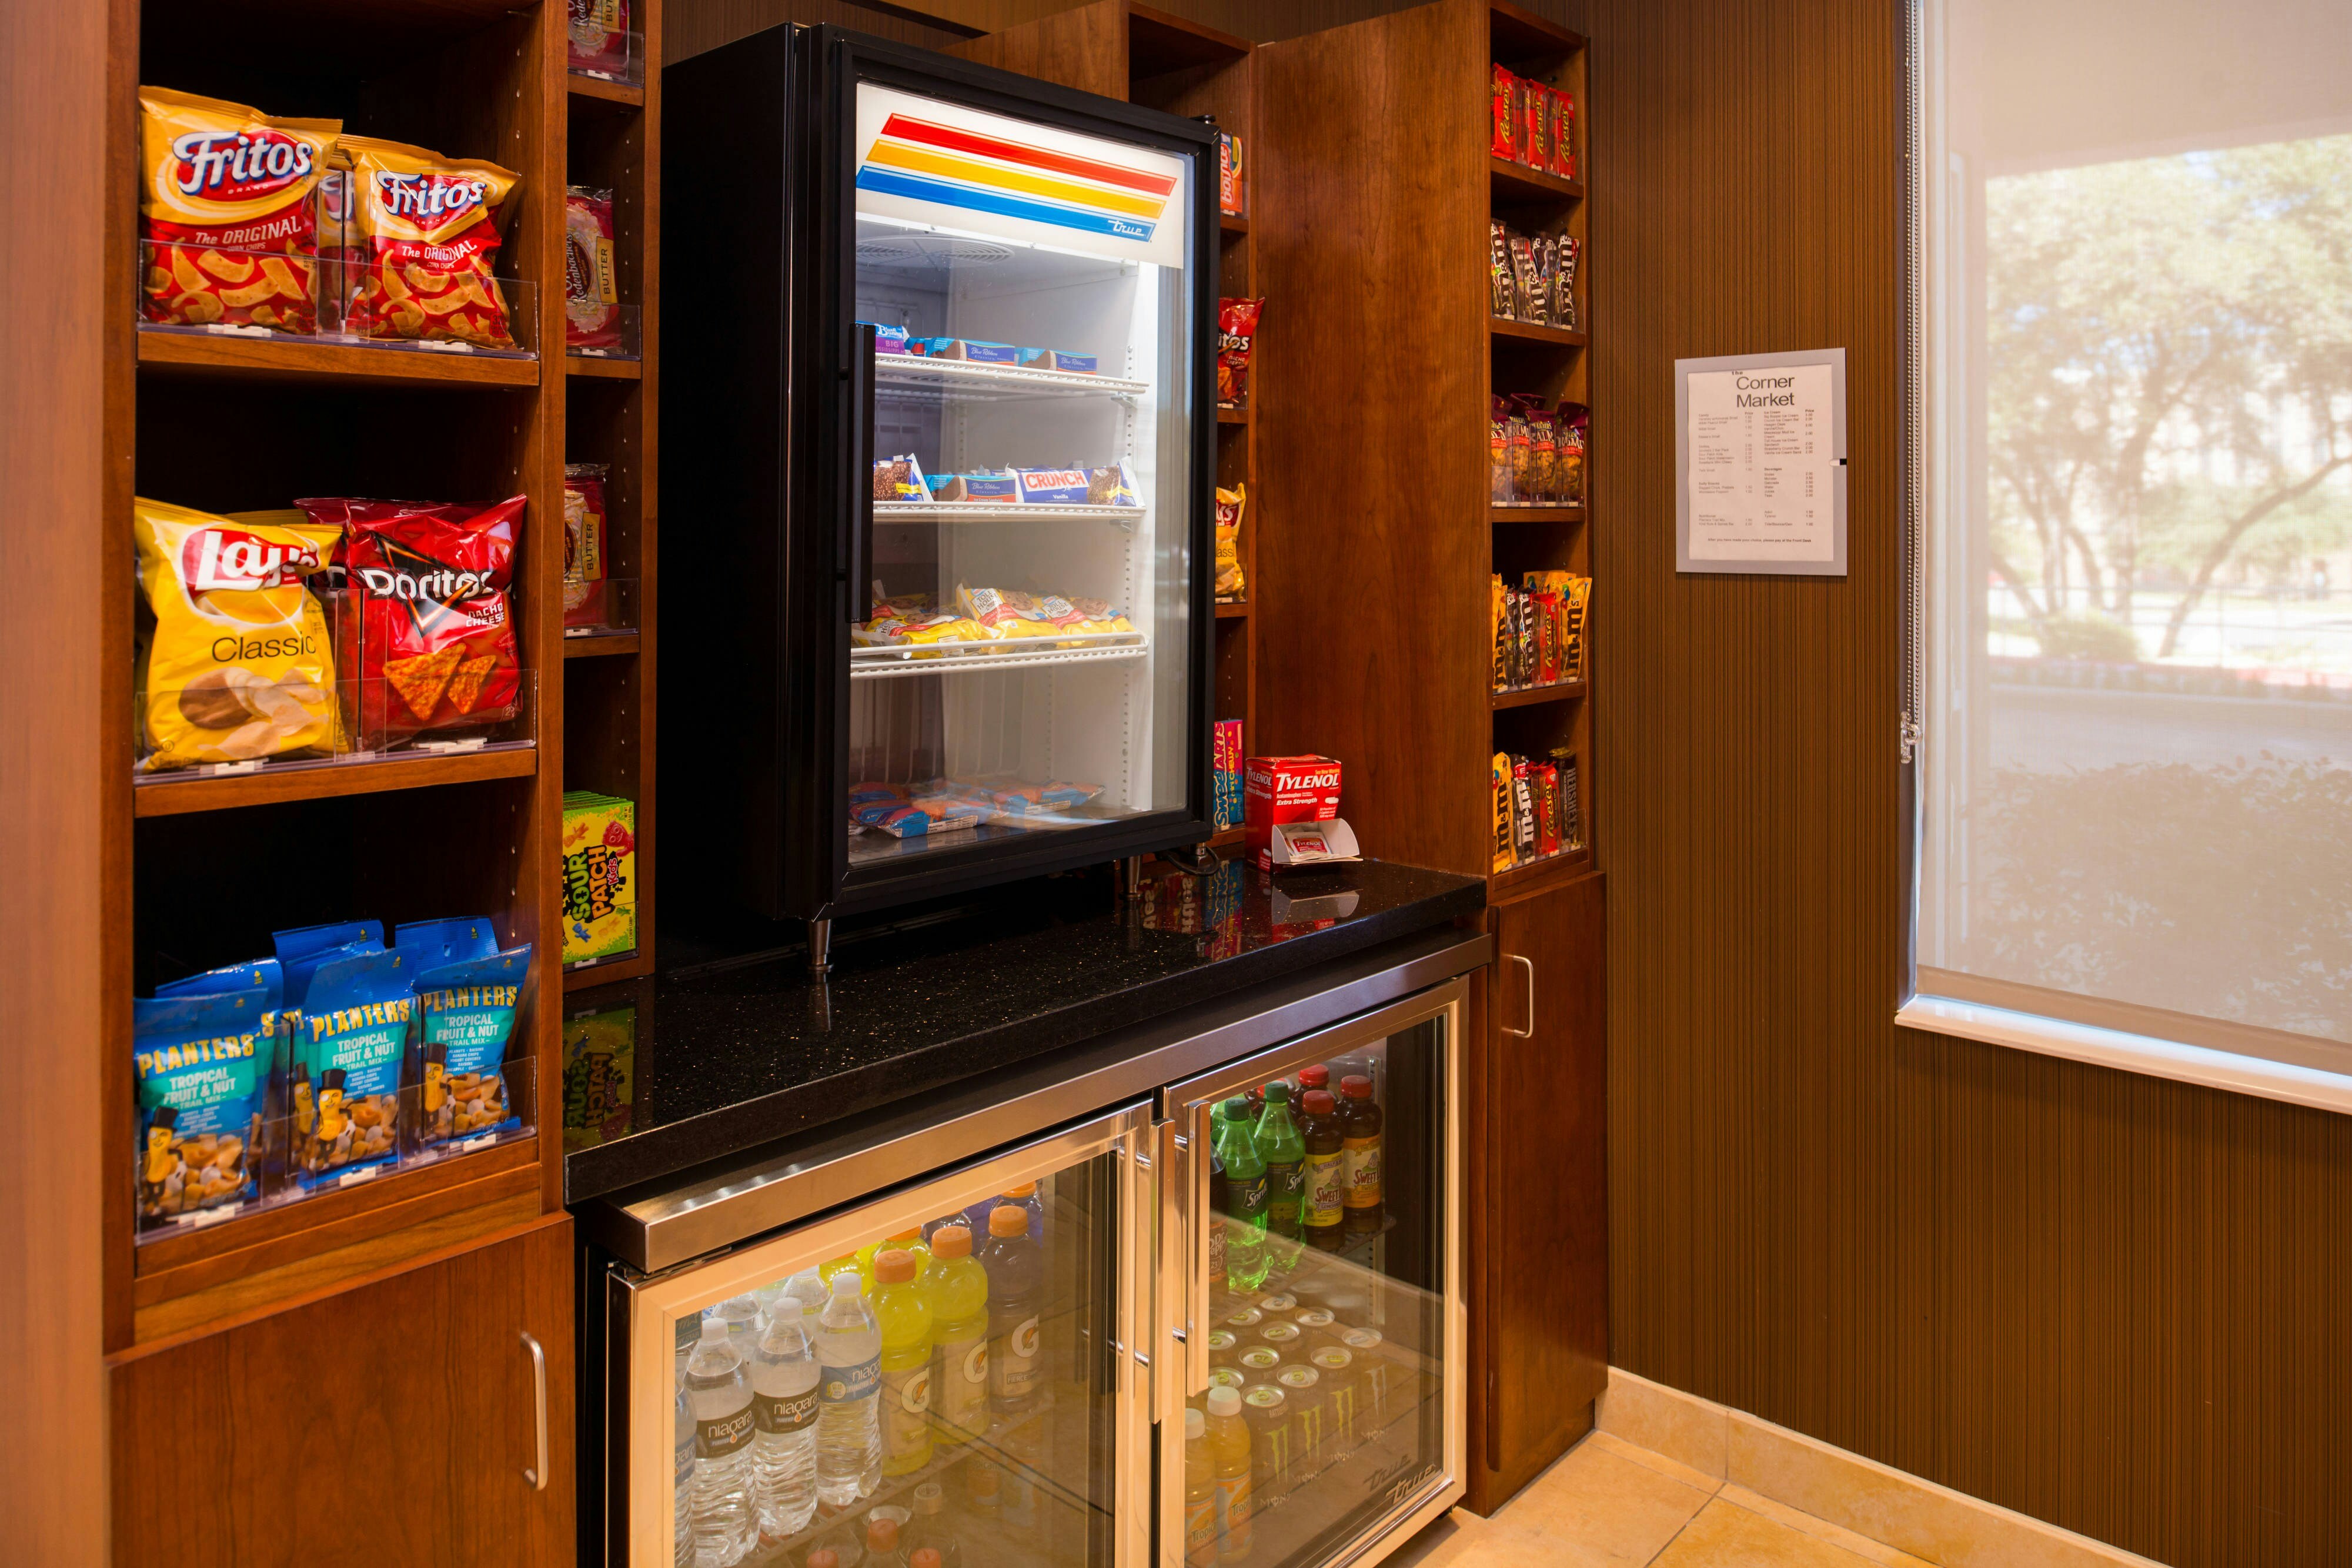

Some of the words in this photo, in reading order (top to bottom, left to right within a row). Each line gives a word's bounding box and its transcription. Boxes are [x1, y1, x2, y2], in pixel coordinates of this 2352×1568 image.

[173, 131, 313, 196] Fritos
[227, 182, 269, 195] BRAND
[376, 170, 487, 216] Fritos
[195, 232, 218, 246] The
[222, 216, 301, 243] ORIGINAL
[402, 246, 420, 258] The
[424, 240, 477, 260] ORIGINAL
[601, 248, 610, 295] BUTTER
[1061, 356, 1073, 365] Blue
[1073, 357, 1086, 366] Ribbon
[1736, 376, 1795, 390] Corner
[1736, 393, 1795, 407] Market
[1025, 473, 1085, 489] CRUNCH
[586, 524, 594, 570] BUTTER
[361, 568, 496, 599] Doritos
[977, 590, 991, 602] TOLL
[977, 594, 998, 610] HOUSE
[466, 612, 505, 627] CHEESE
[469, 603, 503, 618] NACHO
[212, 636, 316, 663] Classic
[1247, 766, 1272, 786] TYLENOL
[1276, 774, 1339, 792] TYLENOL
[1256, 789, 1272, 800] Strength
[608, 857, 619, 886] Kids
[568, 854, 591, 921] SOUR
[589, 845, 612, 920] PATCH
[424, 986, 517, 1014] PLANTERS
[312, 999, 410, 1042] PLANTERS
[444, 1014, 493, 1028] TROPICAL
[338, 1032, 389, 1052] TROPICAL
[436, 1028, 465, 1041] FRUIT
[467, 1027, 475, 1037] &
[478, 1025, 499, 1037] NUT
[138, 1034, 254, 1079] PLANTERS
[333, 1049, 362, 1066] FRUIT
[364, 1047, 372, 1059] &
[375, 1042, 395, 1057] NUT
[346, 1062, 367, 1071] TRAIL
[369, 1057, 382, 1065] MIX
[169, 1067, 229, 1091] TROPICAL
[163, 1088, 199, 1104] FRUIT
[201, 1085, 210, 1097] &
[213, 1078, 236, 1091] NUT
[180, 1099, 203, 1109] TRAIL
[1354, 1169, 1375, 1184] SWEET
[1315, 1186, 1338, 1202] SWEET
[774, 1392, 818, 1416] niagara
[708, 1410, 752, 1439] niagara
